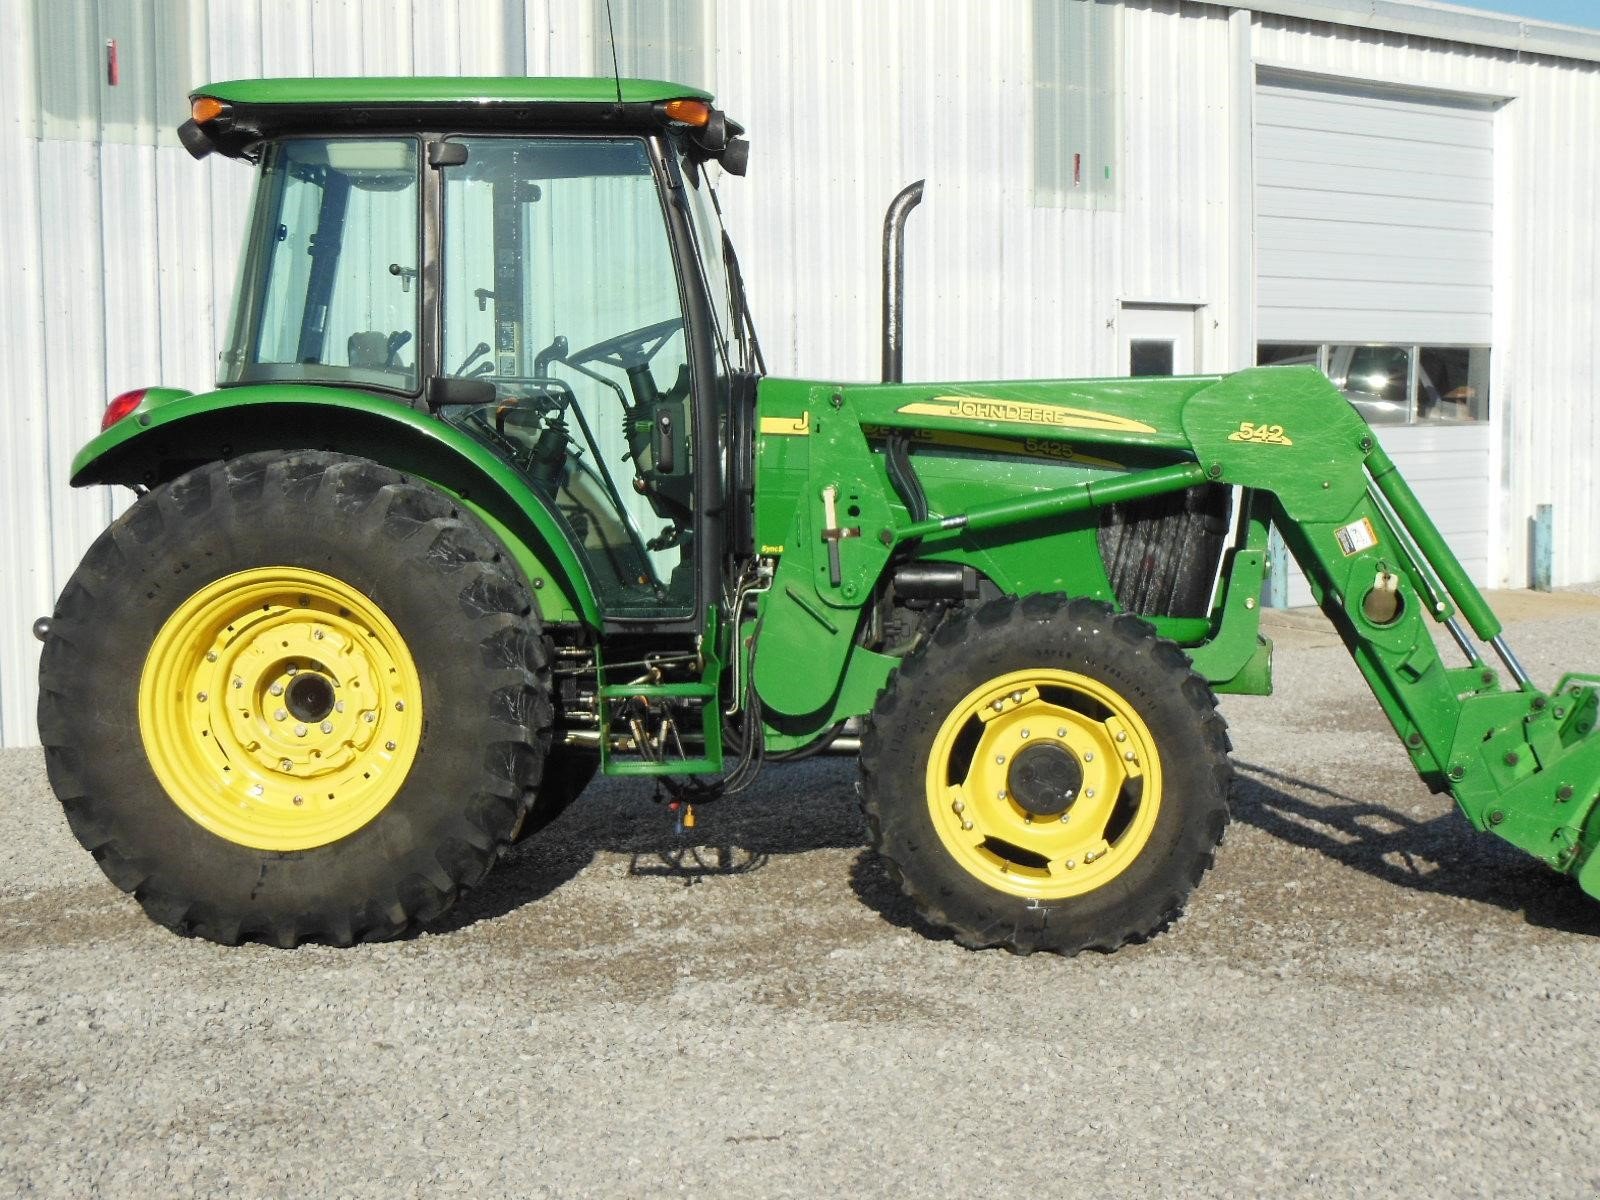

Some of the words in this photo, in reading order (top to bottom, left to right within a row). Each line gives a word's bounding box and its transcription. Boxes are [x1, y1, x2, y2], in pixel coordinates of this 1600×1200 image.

[950, 400, 1002, 419] JOHN
[1004, 404, 1064, 423] DEERE
[1239, 421, 1284, 443] 542
[1024, 438, 1073, 458] 5425
